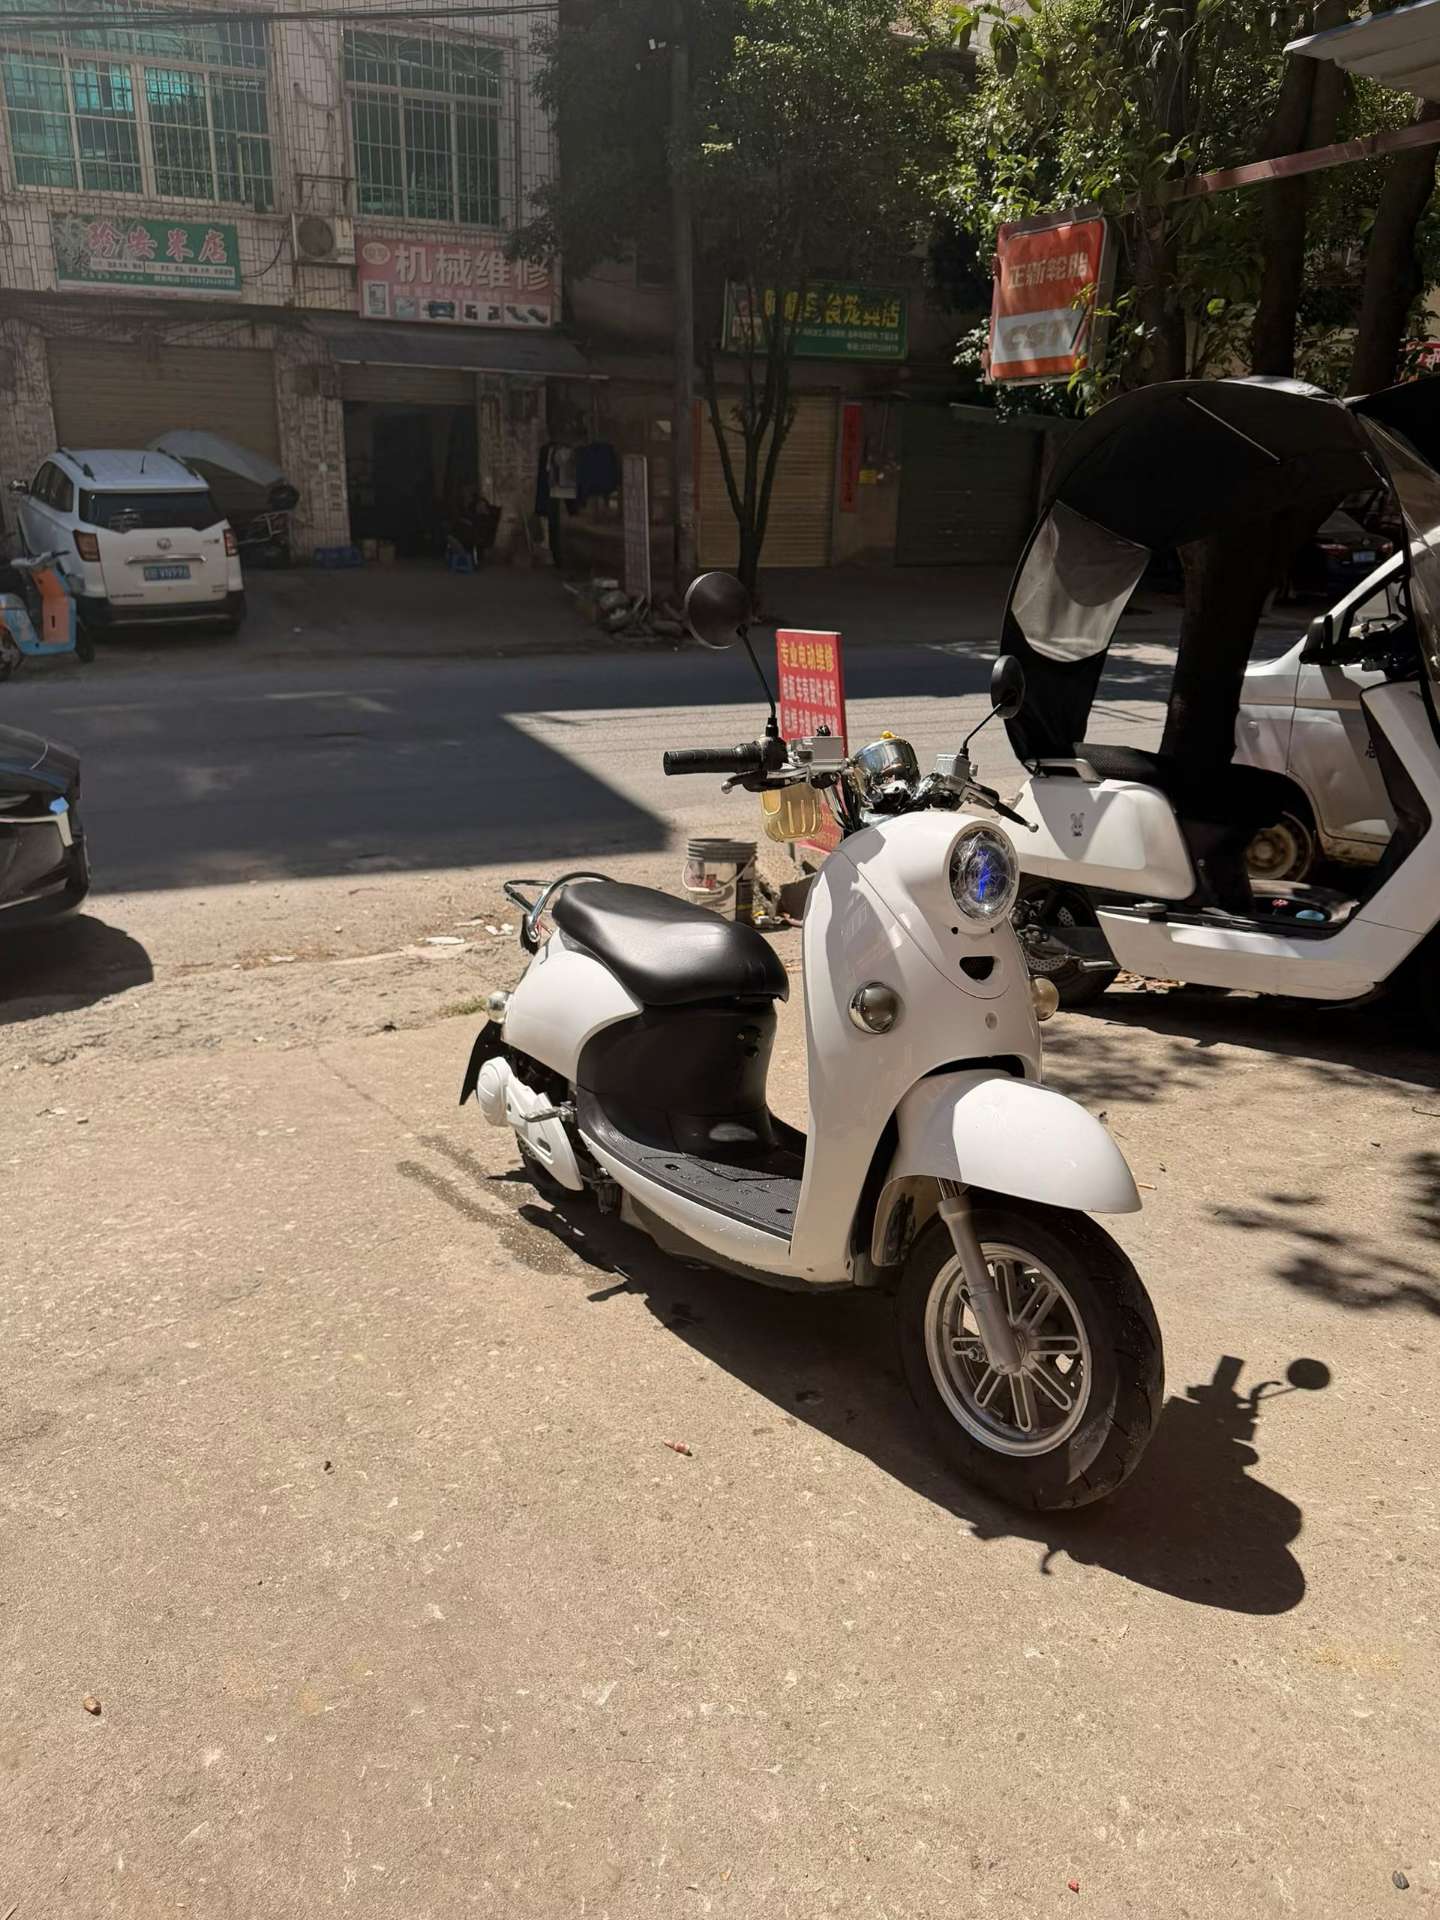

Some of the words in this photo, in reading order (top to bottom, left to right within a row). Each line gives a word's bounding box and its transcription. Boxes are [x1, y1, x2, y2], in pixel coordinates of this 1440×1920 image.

[394, 243, 550, 292] 机械维修
[1008, 252, 1089, 289] 正新轮胎
[1004, 319, 1073, 353] CST
[780, 639, 835, 673] 专业电动维修
